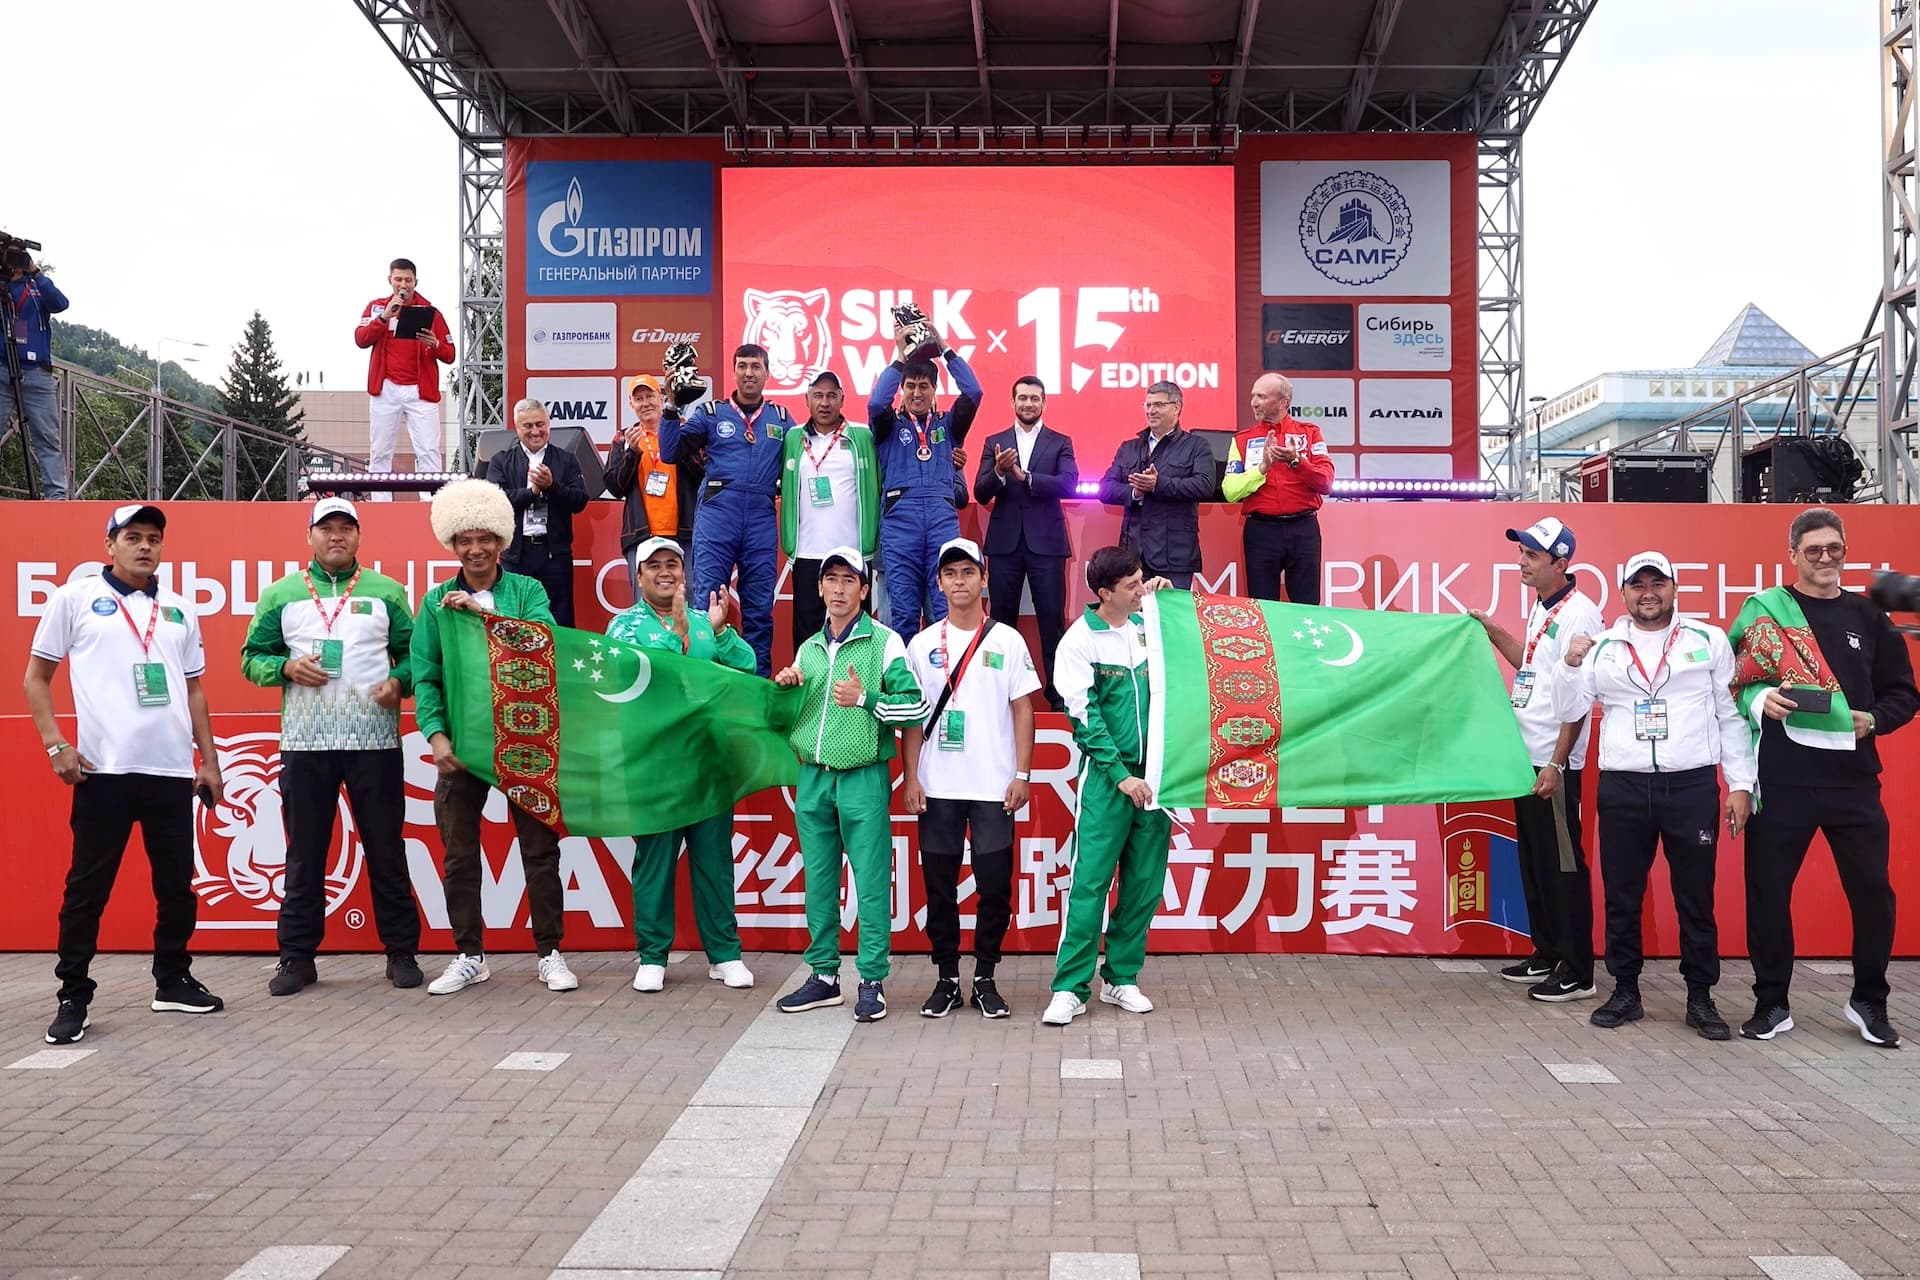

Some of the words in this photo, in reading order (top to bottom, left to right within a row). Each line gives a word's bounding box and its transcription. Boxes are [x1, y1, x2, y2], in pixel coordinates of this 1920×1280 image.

[587, 227, 702, 257] ГАЗПРОМ
[1315, 248, 1397, 265] CAMF
[539, 264, 637, 281] ГЕНЕРАЛЬНЫЙ
[641, 266, 701, 281] ПАРТНЕР
[1366, 316, 1434, 333] Сибирь
[552, 331, 611, 341] ГАЗПРОМБАНК
[1393, 332, 1444, 347] здесь
[1101, 363, 1219, 388] EDITION
[1369, 407, 1443, 419] АЛТАЙ
